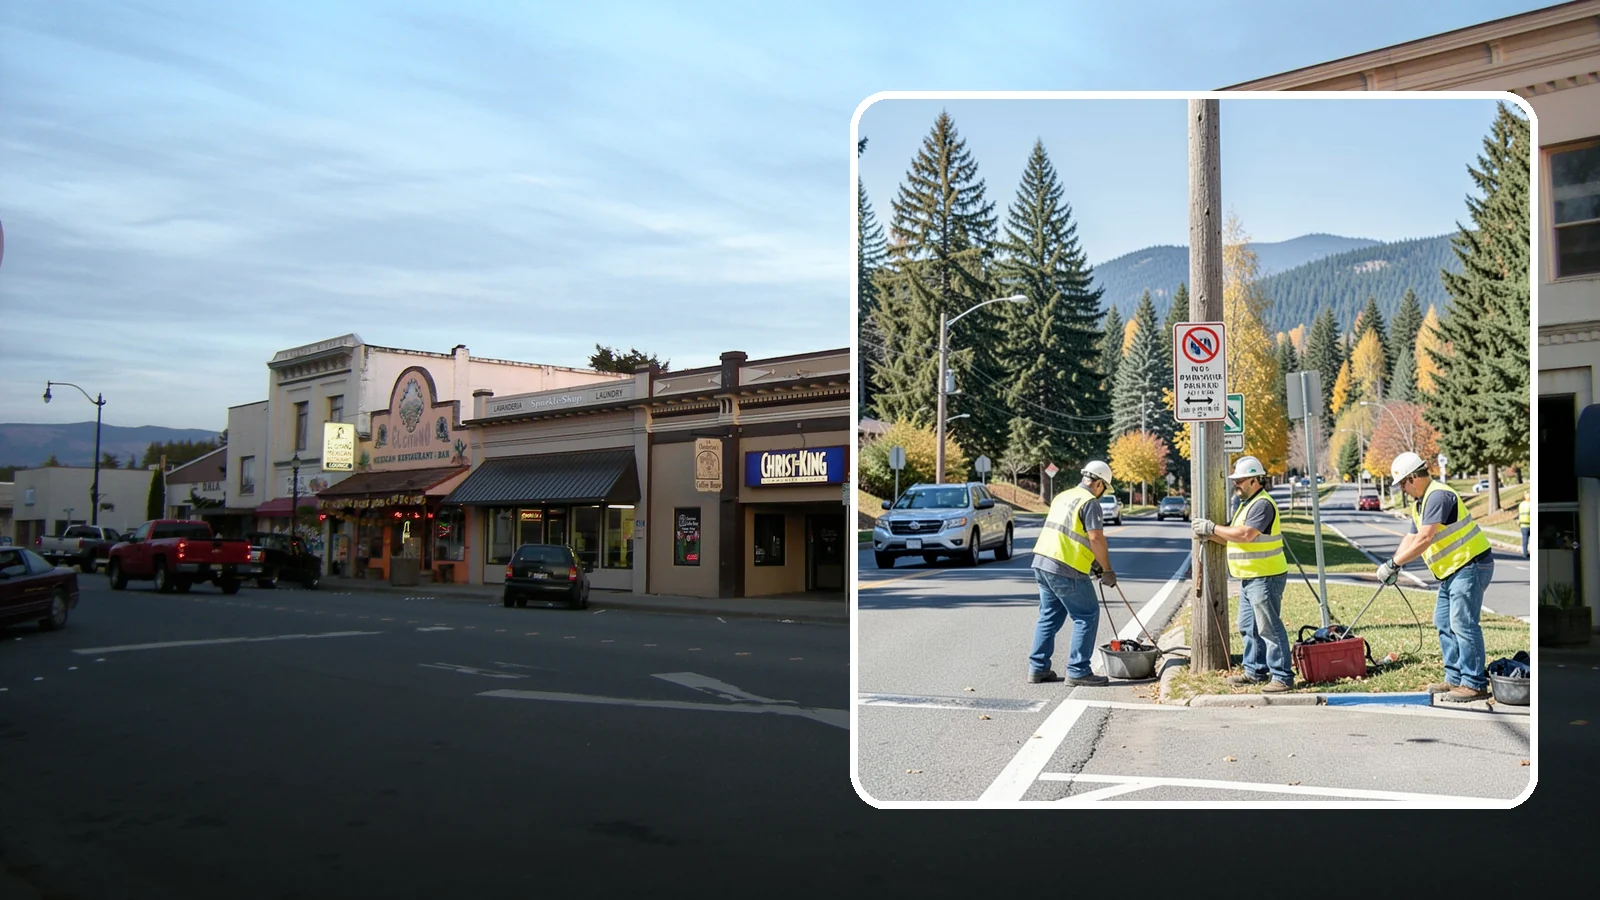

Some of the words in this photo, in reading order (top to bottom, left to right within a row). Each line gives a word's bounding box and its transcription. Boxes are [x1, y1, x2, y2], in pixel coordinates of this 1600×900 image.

[493, 402, 522, 412] LAVANDERIA
[562, 394, 582, 406] Shop
[595, 389, 623, 400] LAUNDRY
[373, 454, 396, 464] MEXICAN
[397, 451, 434, 462] RESTAURANT
[438, 450, 450, 459] BAR
[799, 450, 827, 476] KING
